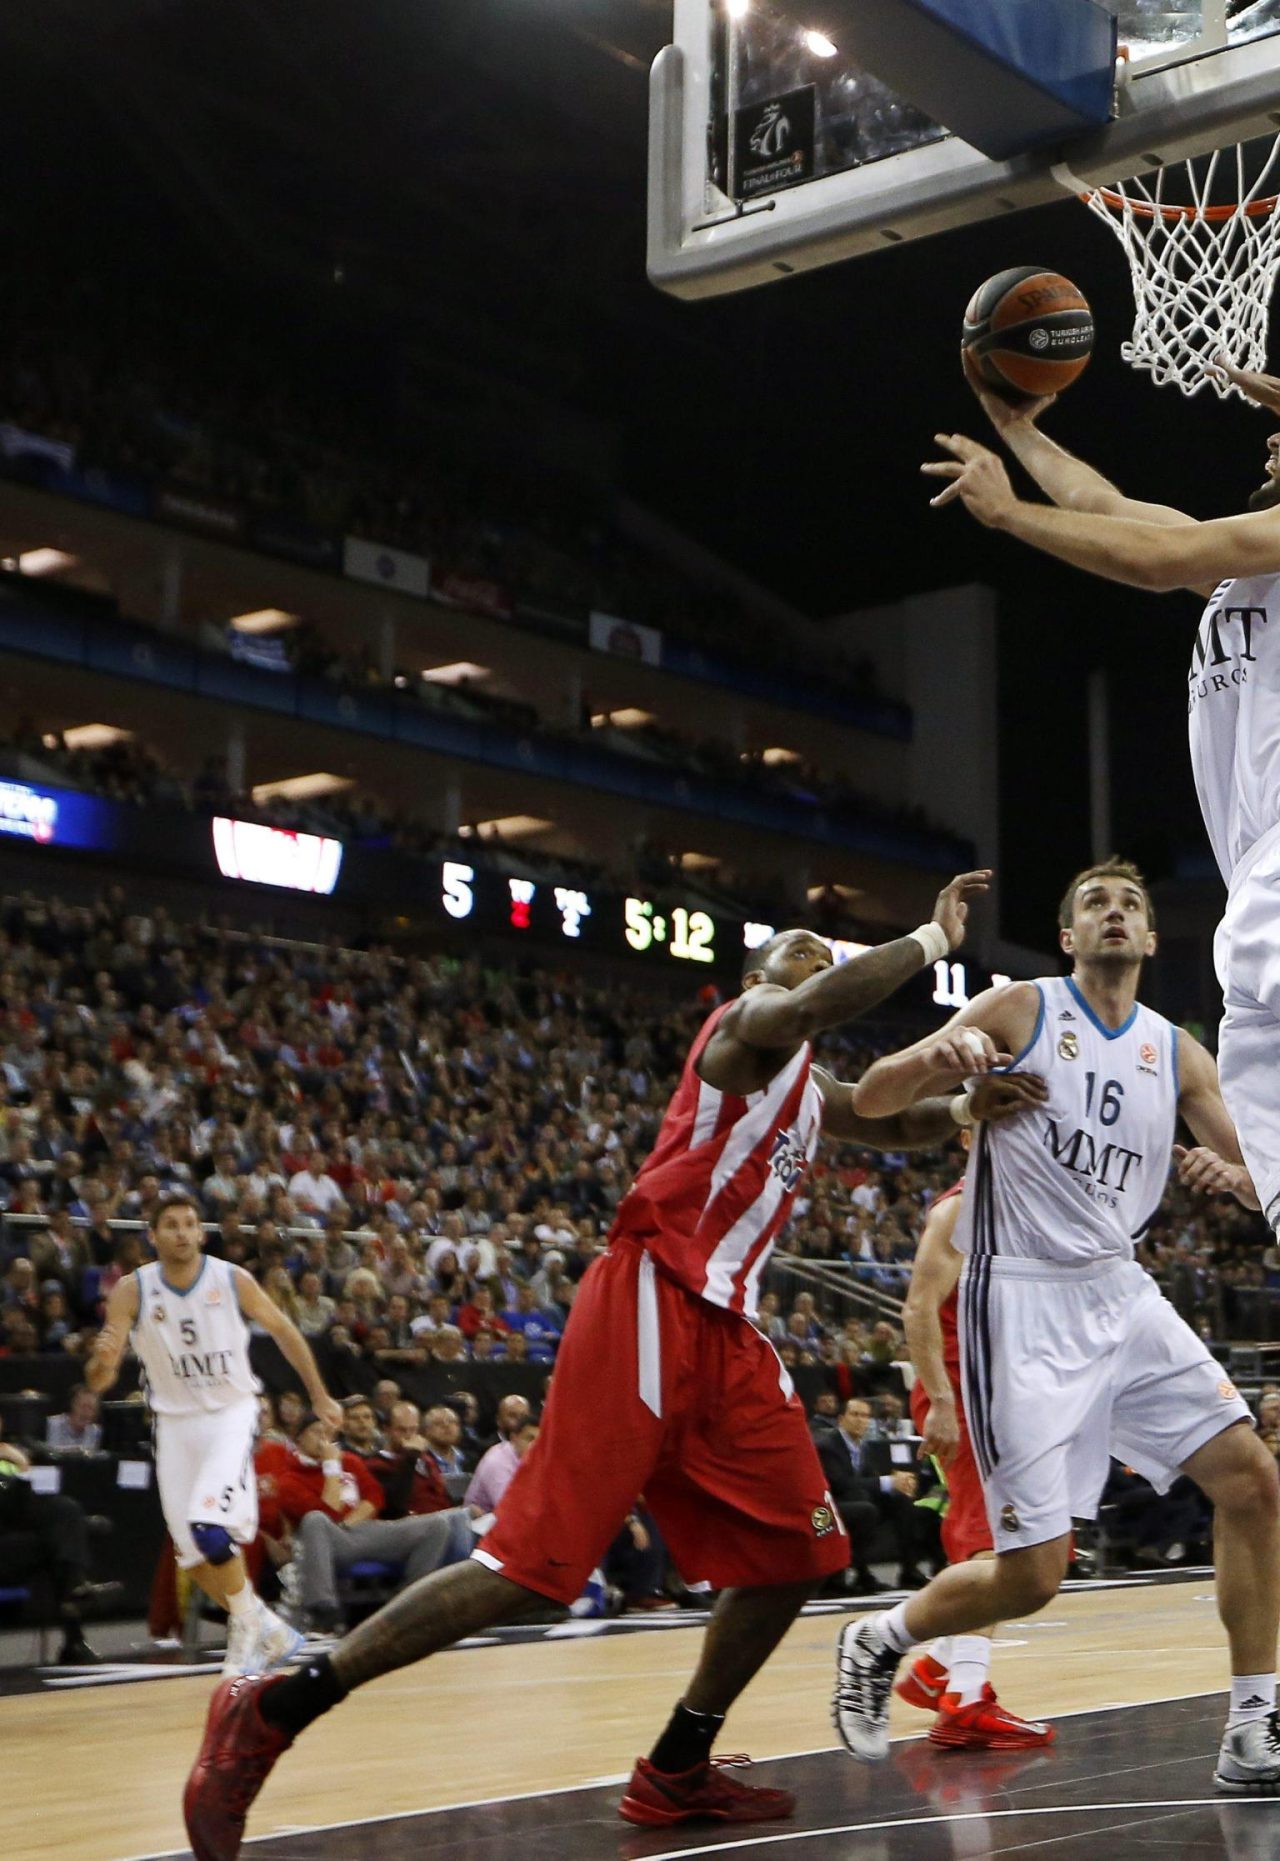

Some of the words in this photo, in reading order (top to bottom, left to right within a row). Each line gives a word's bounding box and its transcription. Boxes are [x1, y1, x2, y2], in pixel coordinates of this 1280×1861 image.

[442, 861, 474, 919] 5
[933, 959, 970, 1009] 11
[1084, 1071, 1125, 1127] 16
[1043, 1117, 1143, 1193] MMT
[179, 1318, 198, 1346] 5
[168, 1350, 233, 1378] MMT
[220, 1484, 235, 1514] 5
